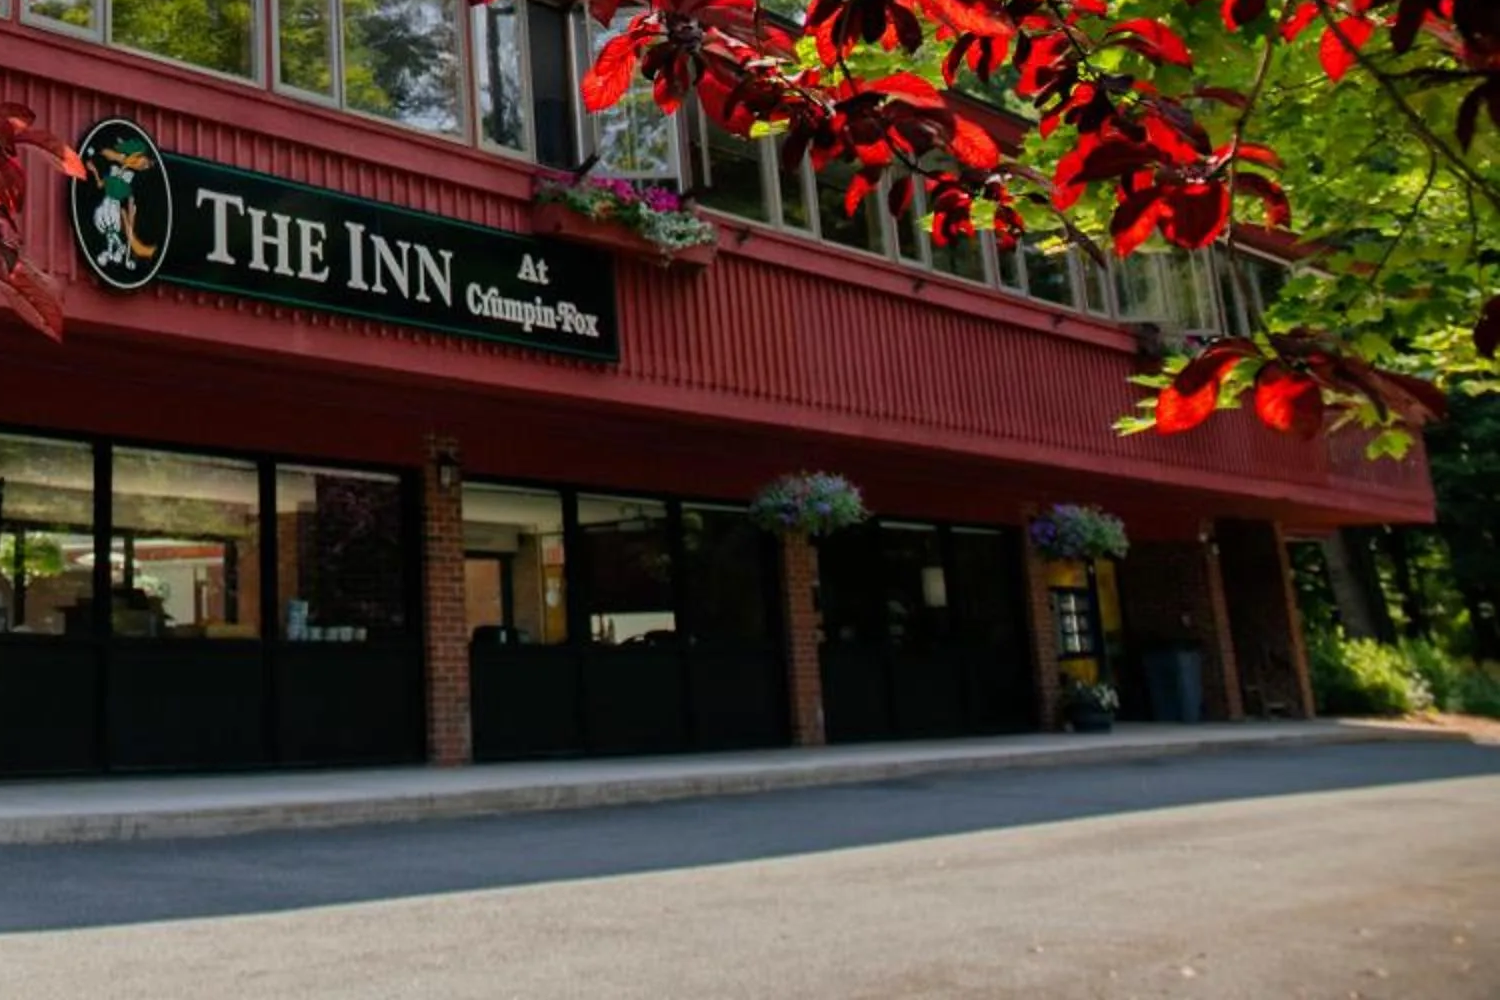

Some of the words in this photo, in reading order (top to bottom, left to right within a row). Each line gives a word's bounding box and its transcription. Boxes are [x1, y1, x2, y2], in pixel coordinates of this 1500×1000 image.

[196, 187, 330, 283] THE
[343, 220, 453, 308] INN
[516, 252, 549, 285] At
[465, 281, 600, 338] Crumpin-Fox
